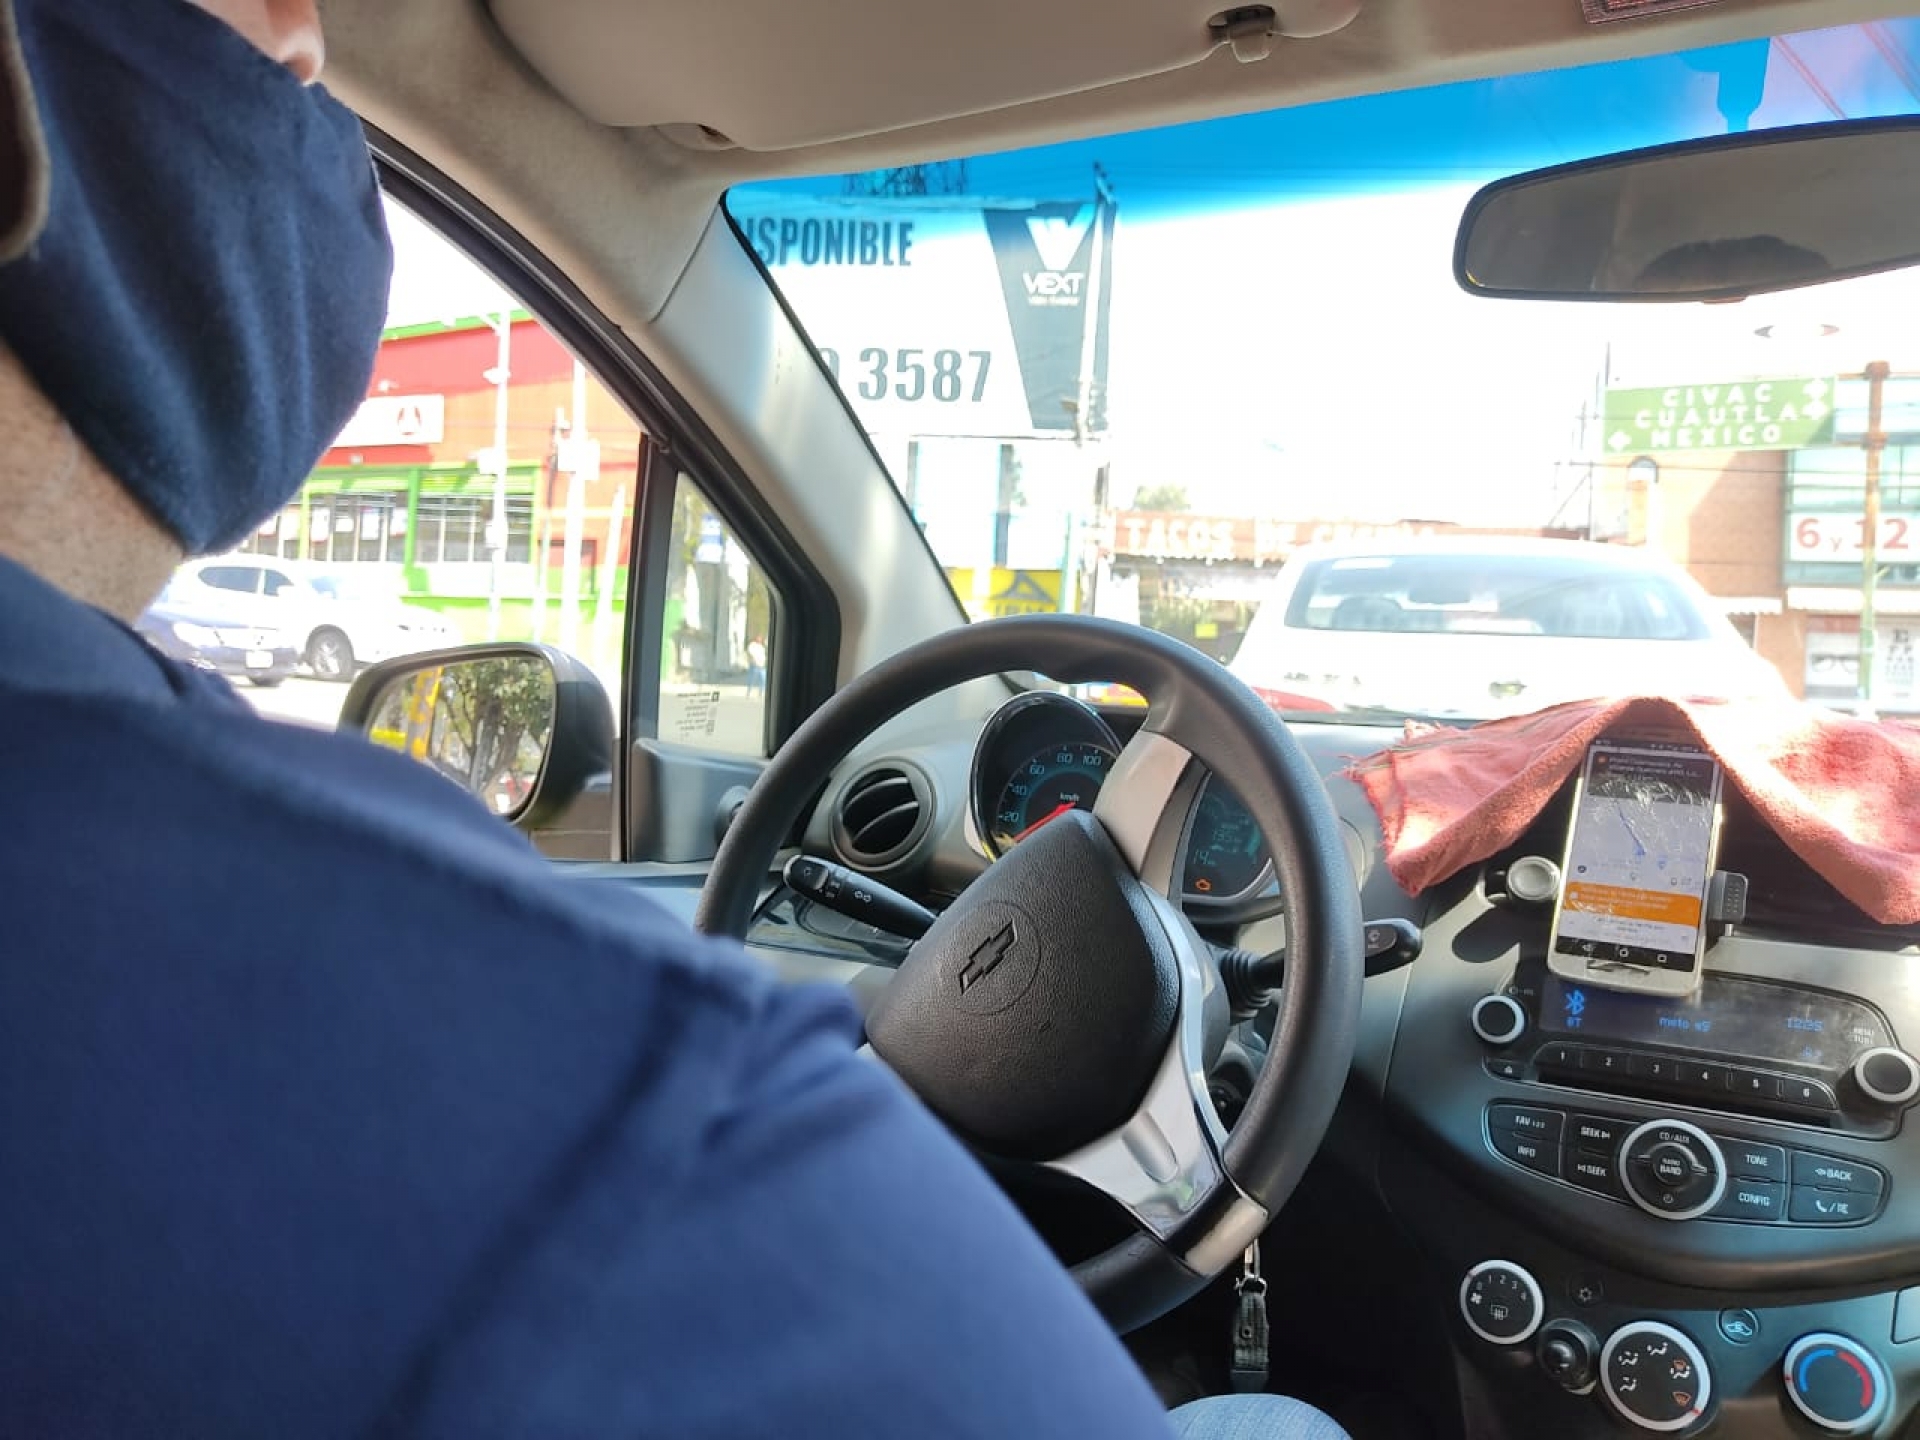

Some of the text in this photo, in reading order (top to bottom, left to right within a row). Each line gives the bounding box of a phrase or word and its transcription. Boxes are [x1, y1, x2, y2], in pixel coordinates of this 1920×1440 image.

[741, 216, 914, 267] ISPONIBLE
[1023, 272, 1085, 295] VEXT
[858, 347, 992, 402] 3587
[1661, 384, 1773, 407] CIVAC
[1634, 402, 1800, 429] CUAUTLA
[1650, 424, 1782, 448] MEXICO
[1124, 517, 1235, 558] TACOS
[1796, 518, 1820, 548] 6
[1056, 752, 1073, 764] 80
[1082, 755, 1102, 766] 100
[1029, 764, 1045, 775] 60
[1012, 785, 1027, 796] 40
[1004, 812, 1019, 823] 20
[1605, 1056, 1612, 1066] 2
[1652, 1063, 1659, 1073] 3
[1701, 1070, 1708, 1080] 4
[1752, 1078, 1759, 1088] 5
[1803, 1087, 1810, 1098] 6
[1745, 1154, 1769, 1167] TONE
[1826, 1168, 1853, 1182] BACK
[1738, 1191, 1771, 1208] CONFIG
